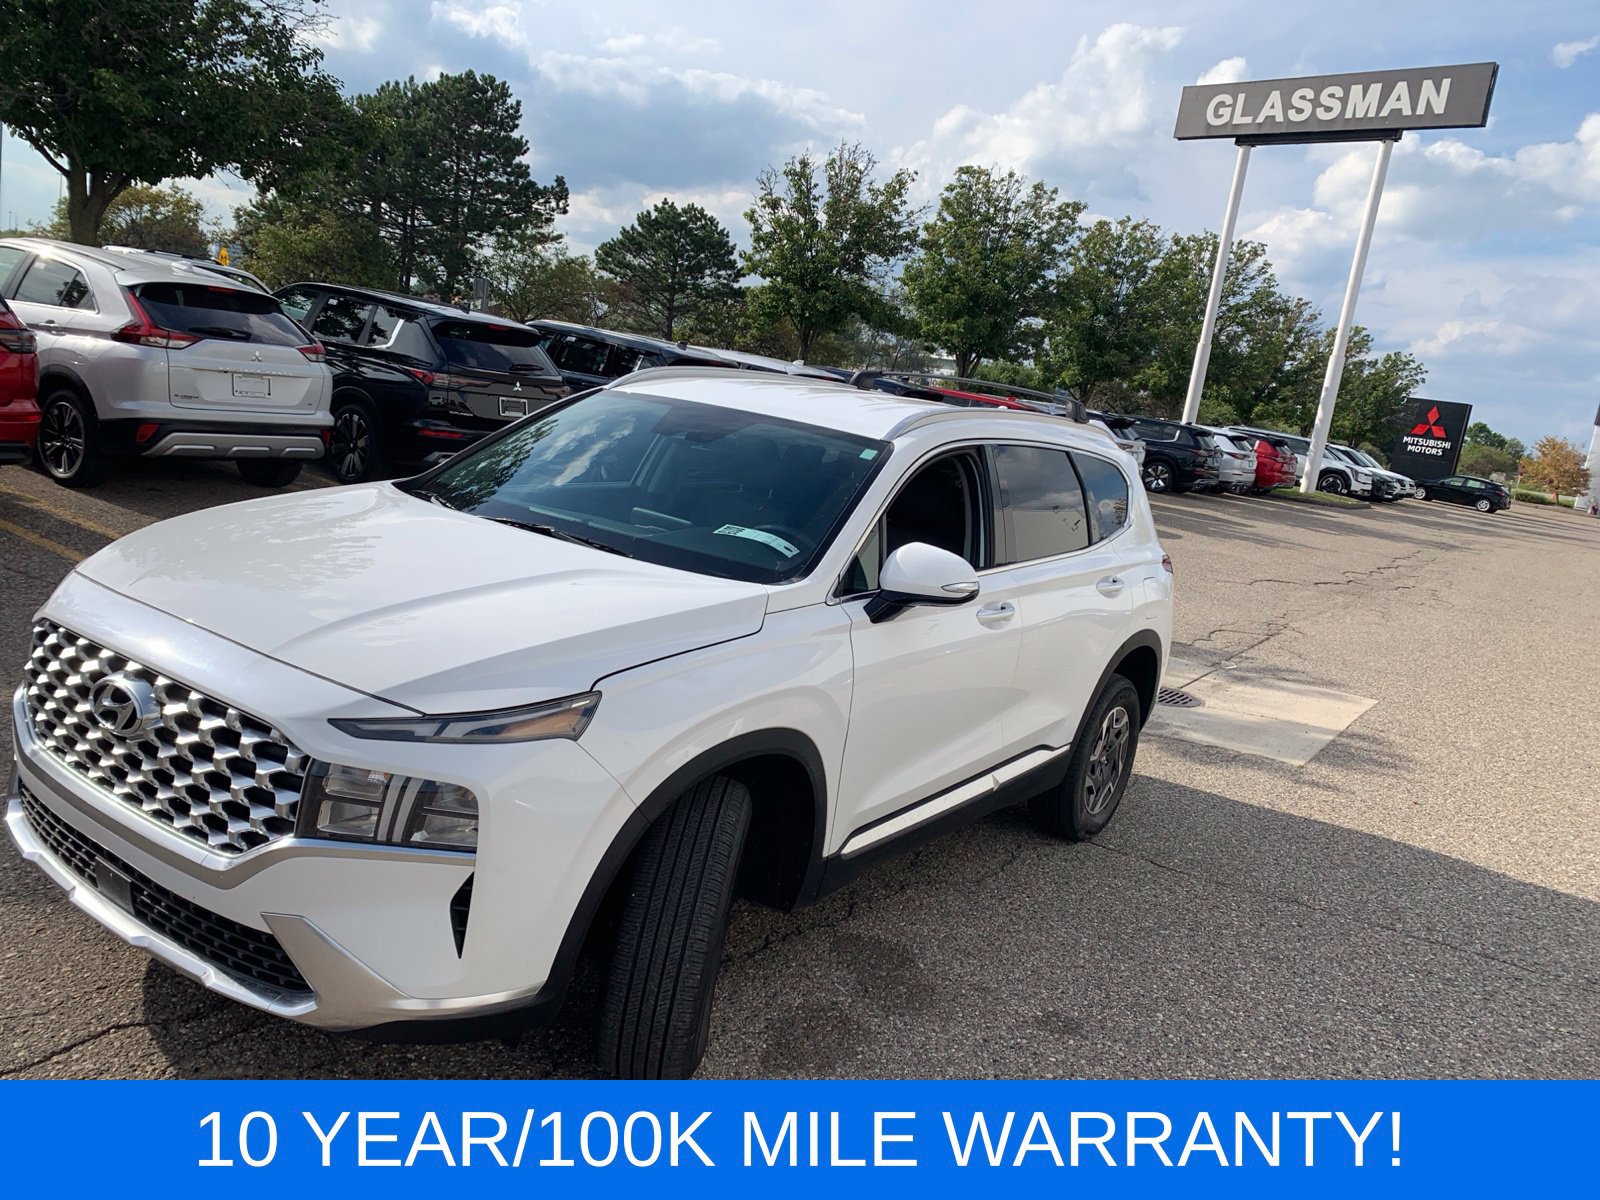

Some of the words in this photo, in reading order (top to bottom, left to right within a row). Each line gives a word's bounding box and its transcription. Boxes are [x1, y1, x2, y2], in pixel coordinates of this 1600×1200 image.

[1206, 78, 1451, 126] GLASSMAN
[1402, 436, 1451, 449] MITSUBISHI
[1407, 444, 1443, 456] MOTORS
